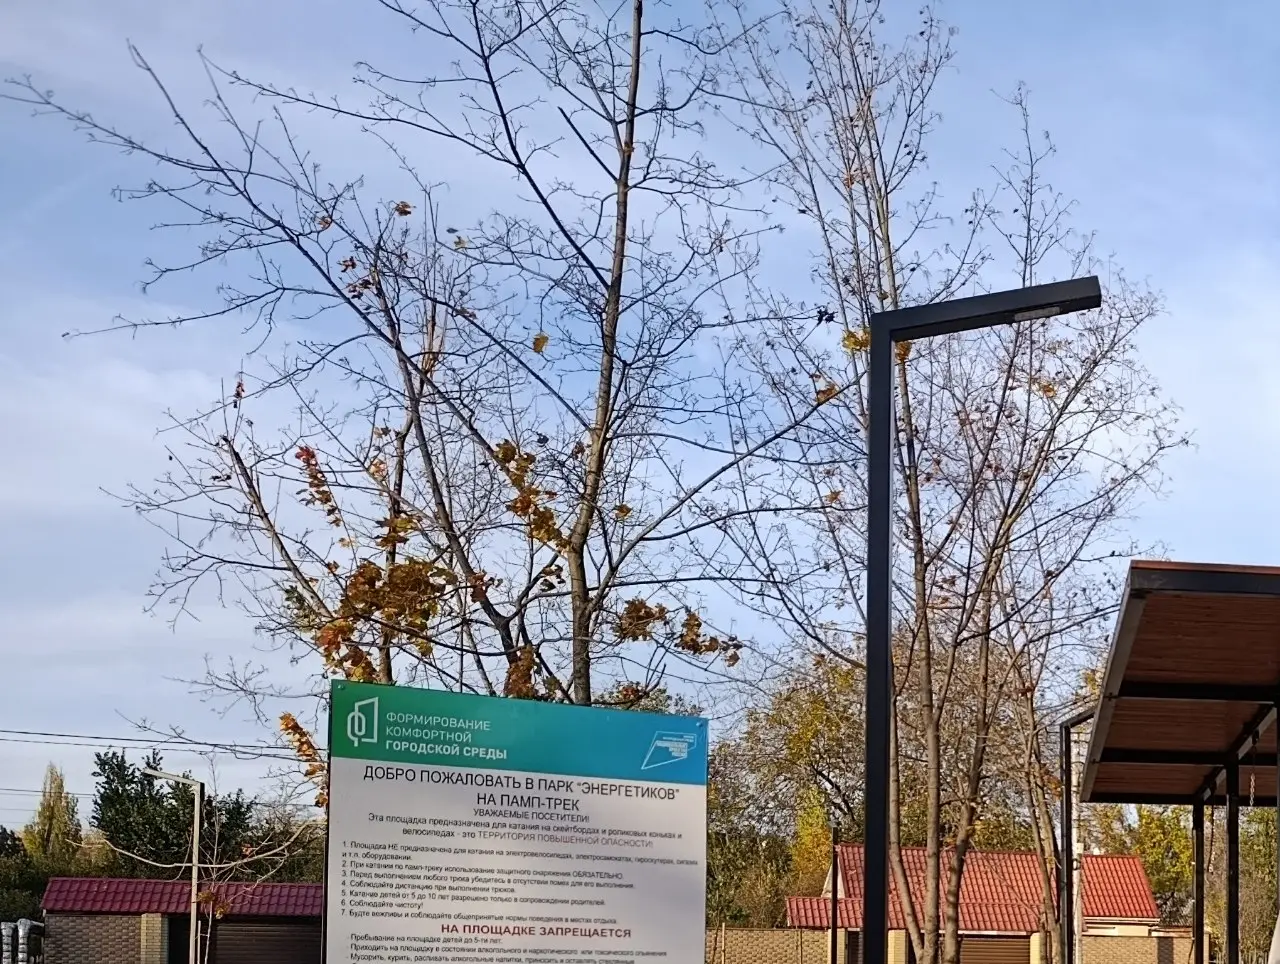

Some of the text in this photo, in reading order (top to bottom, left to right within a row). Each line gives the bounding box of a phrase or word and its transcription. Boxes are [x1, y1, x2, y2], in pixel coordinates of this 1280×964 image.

[386, 711, 491, 731] ФОРМИРОВАНИЕ
[386, 726, 472, 743] КОМФОРТНОЙ
[386, 740, 507, 760] ГОРОДСКОЙ СРЕДЫ
[363, 764, 416, 783] ДОБРО
[420, 769, 521, 789] ПОЖАЛОВАТЬ
[525, 777, 534, 790] В
[537, 778, 573, 793] ПАРК
[476, 792, 579, 811] НА ПАМП-ТРЕК
[368, 812, 383, 821] Эта
[385, 815, 426, 825] площадка
[428, 817, 490, 829] предназначена
[491, 821, 506, 830] для
[508, 822, 539, 831] катания
[552, 823, 599, 835] скейтбордах
[473, 807, 589, 823] УВАЖАЕМЫЕ ПОСЕТИТЕЛИ!
[441, 923, 630, 938] НА ПЛОЩАДКЕ ЗАПРЕЩАЕТСЯ
